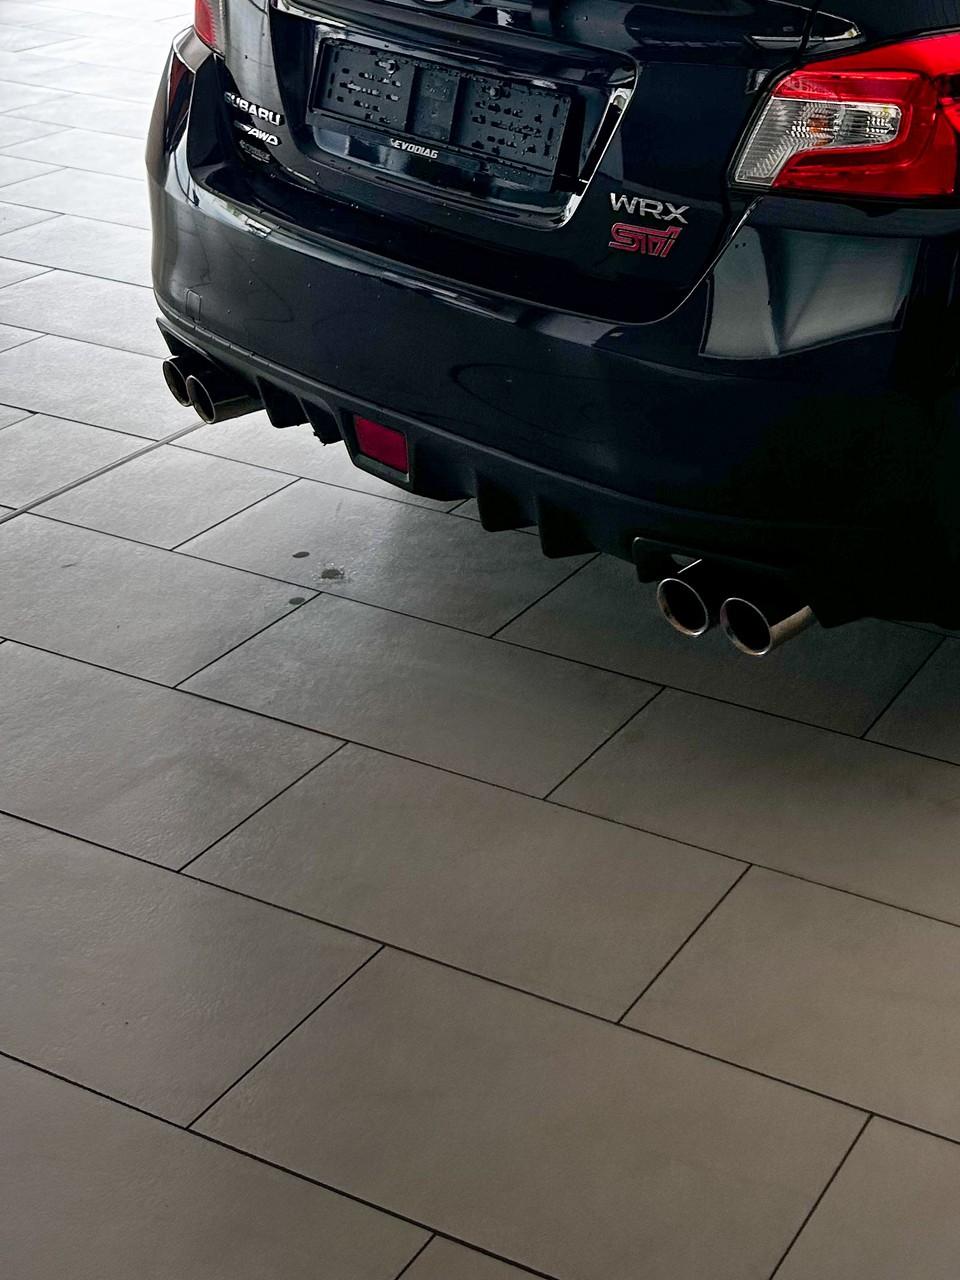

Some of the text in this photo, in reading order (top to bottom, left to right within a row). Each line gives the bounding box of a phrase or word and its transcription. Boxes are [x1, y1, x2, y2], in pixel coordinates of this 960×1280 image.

[223, 91, 281, 126] SUBARU
[247, 127, 279, 146] AWD
[610, 192, 690, 224] WRX
